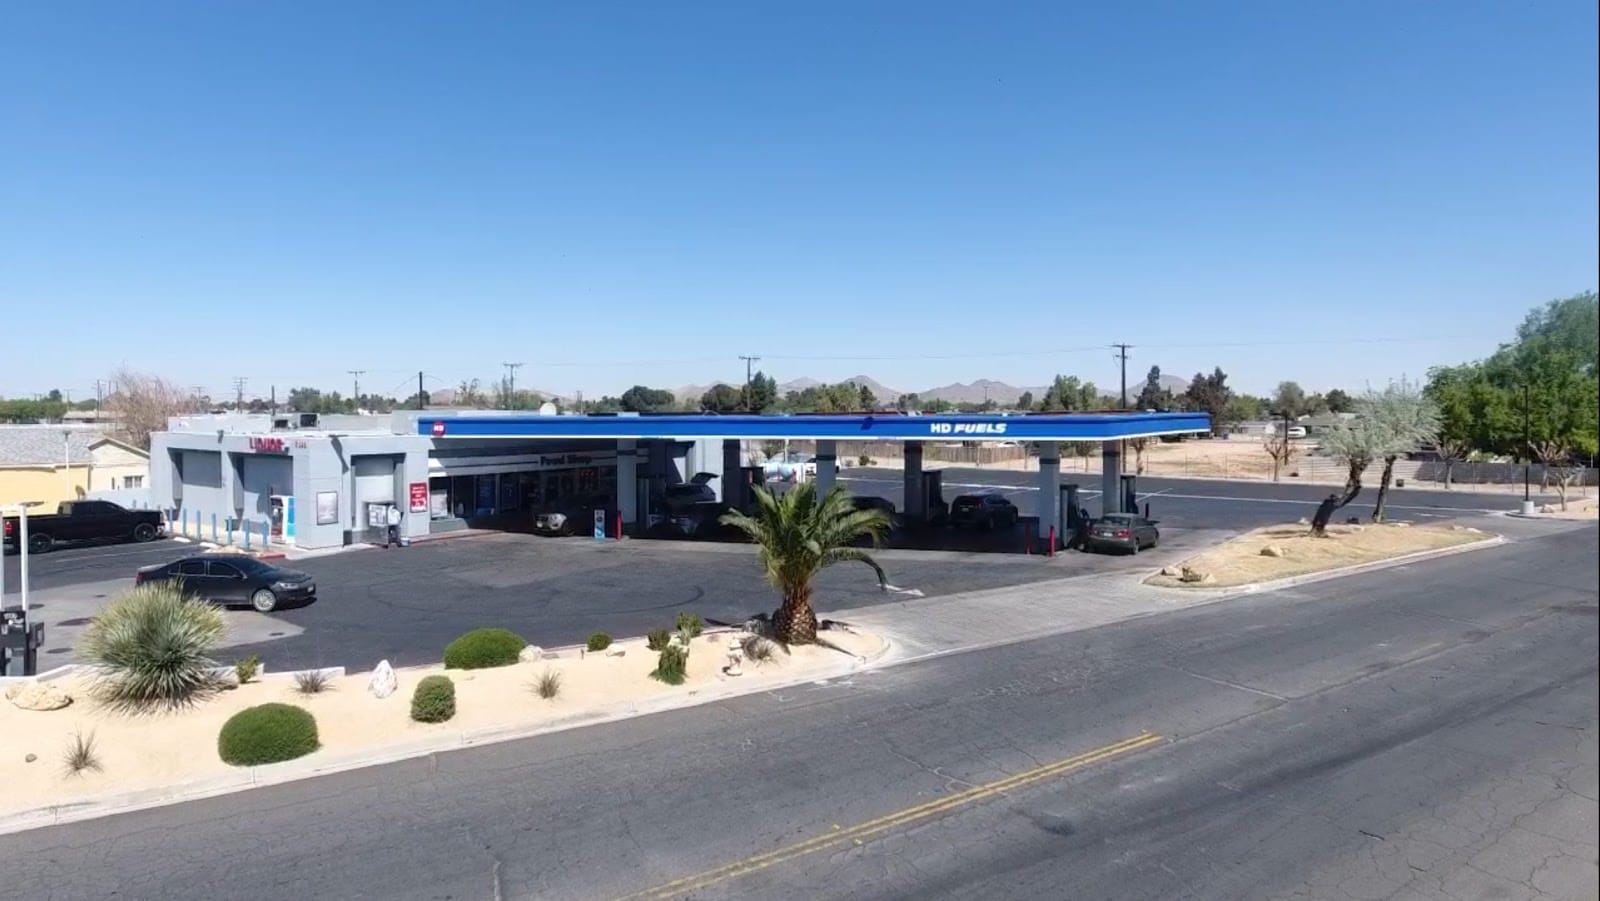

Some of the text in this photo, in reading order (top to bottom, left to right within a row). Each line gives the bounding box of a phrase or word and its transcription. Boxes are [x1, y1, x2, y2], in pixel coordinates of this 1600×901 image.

[930, 423, 1008, 433] HD FUELS
[540, 454, 565, 466] Food
